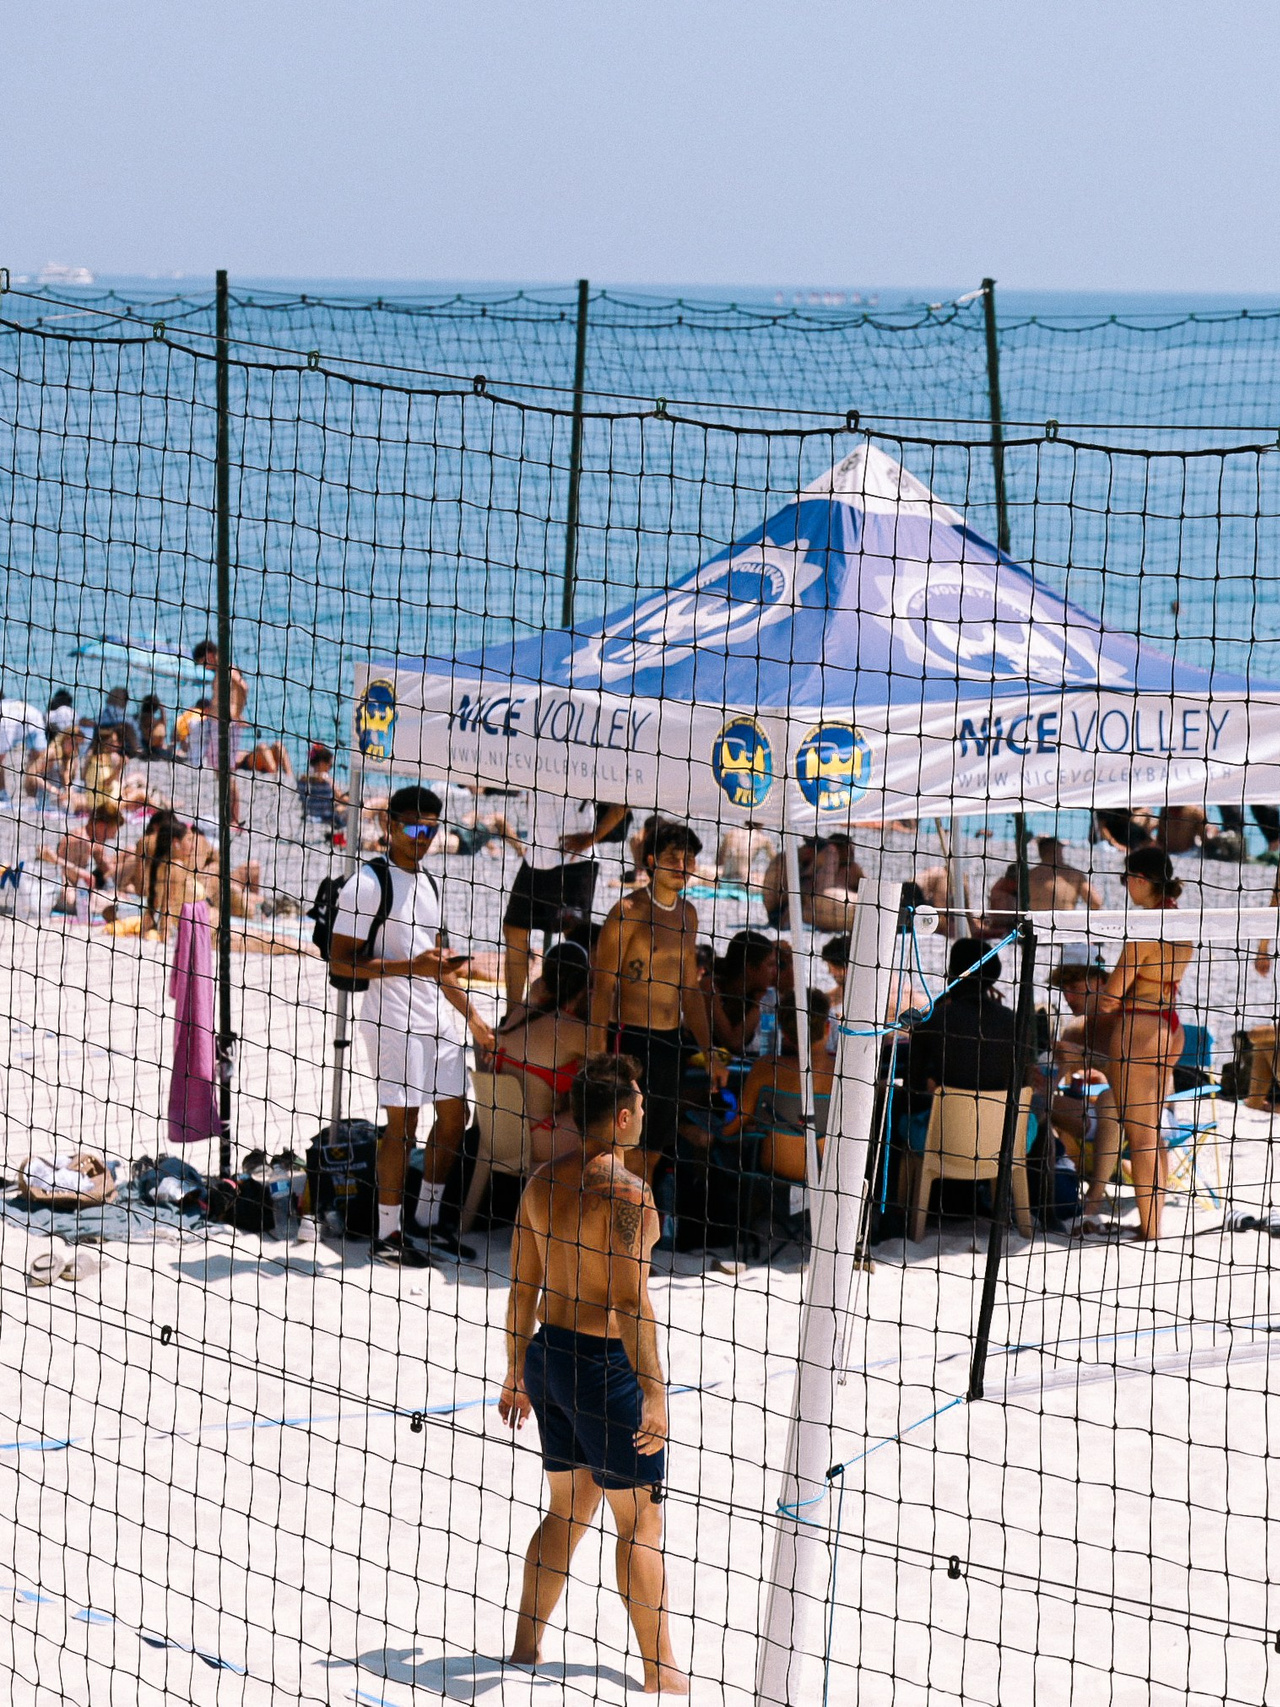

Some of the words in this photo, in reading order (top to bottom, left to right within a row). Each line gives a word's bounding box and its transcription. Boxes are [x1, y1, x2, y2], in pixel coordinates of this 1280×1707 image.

[447, 694, 525, 737] NICE
[533, 698, 652, 752] VOLLEY
[959, 712, 1058, 758] NICE
[1071, 709, 1230, 752] VOLLEY
